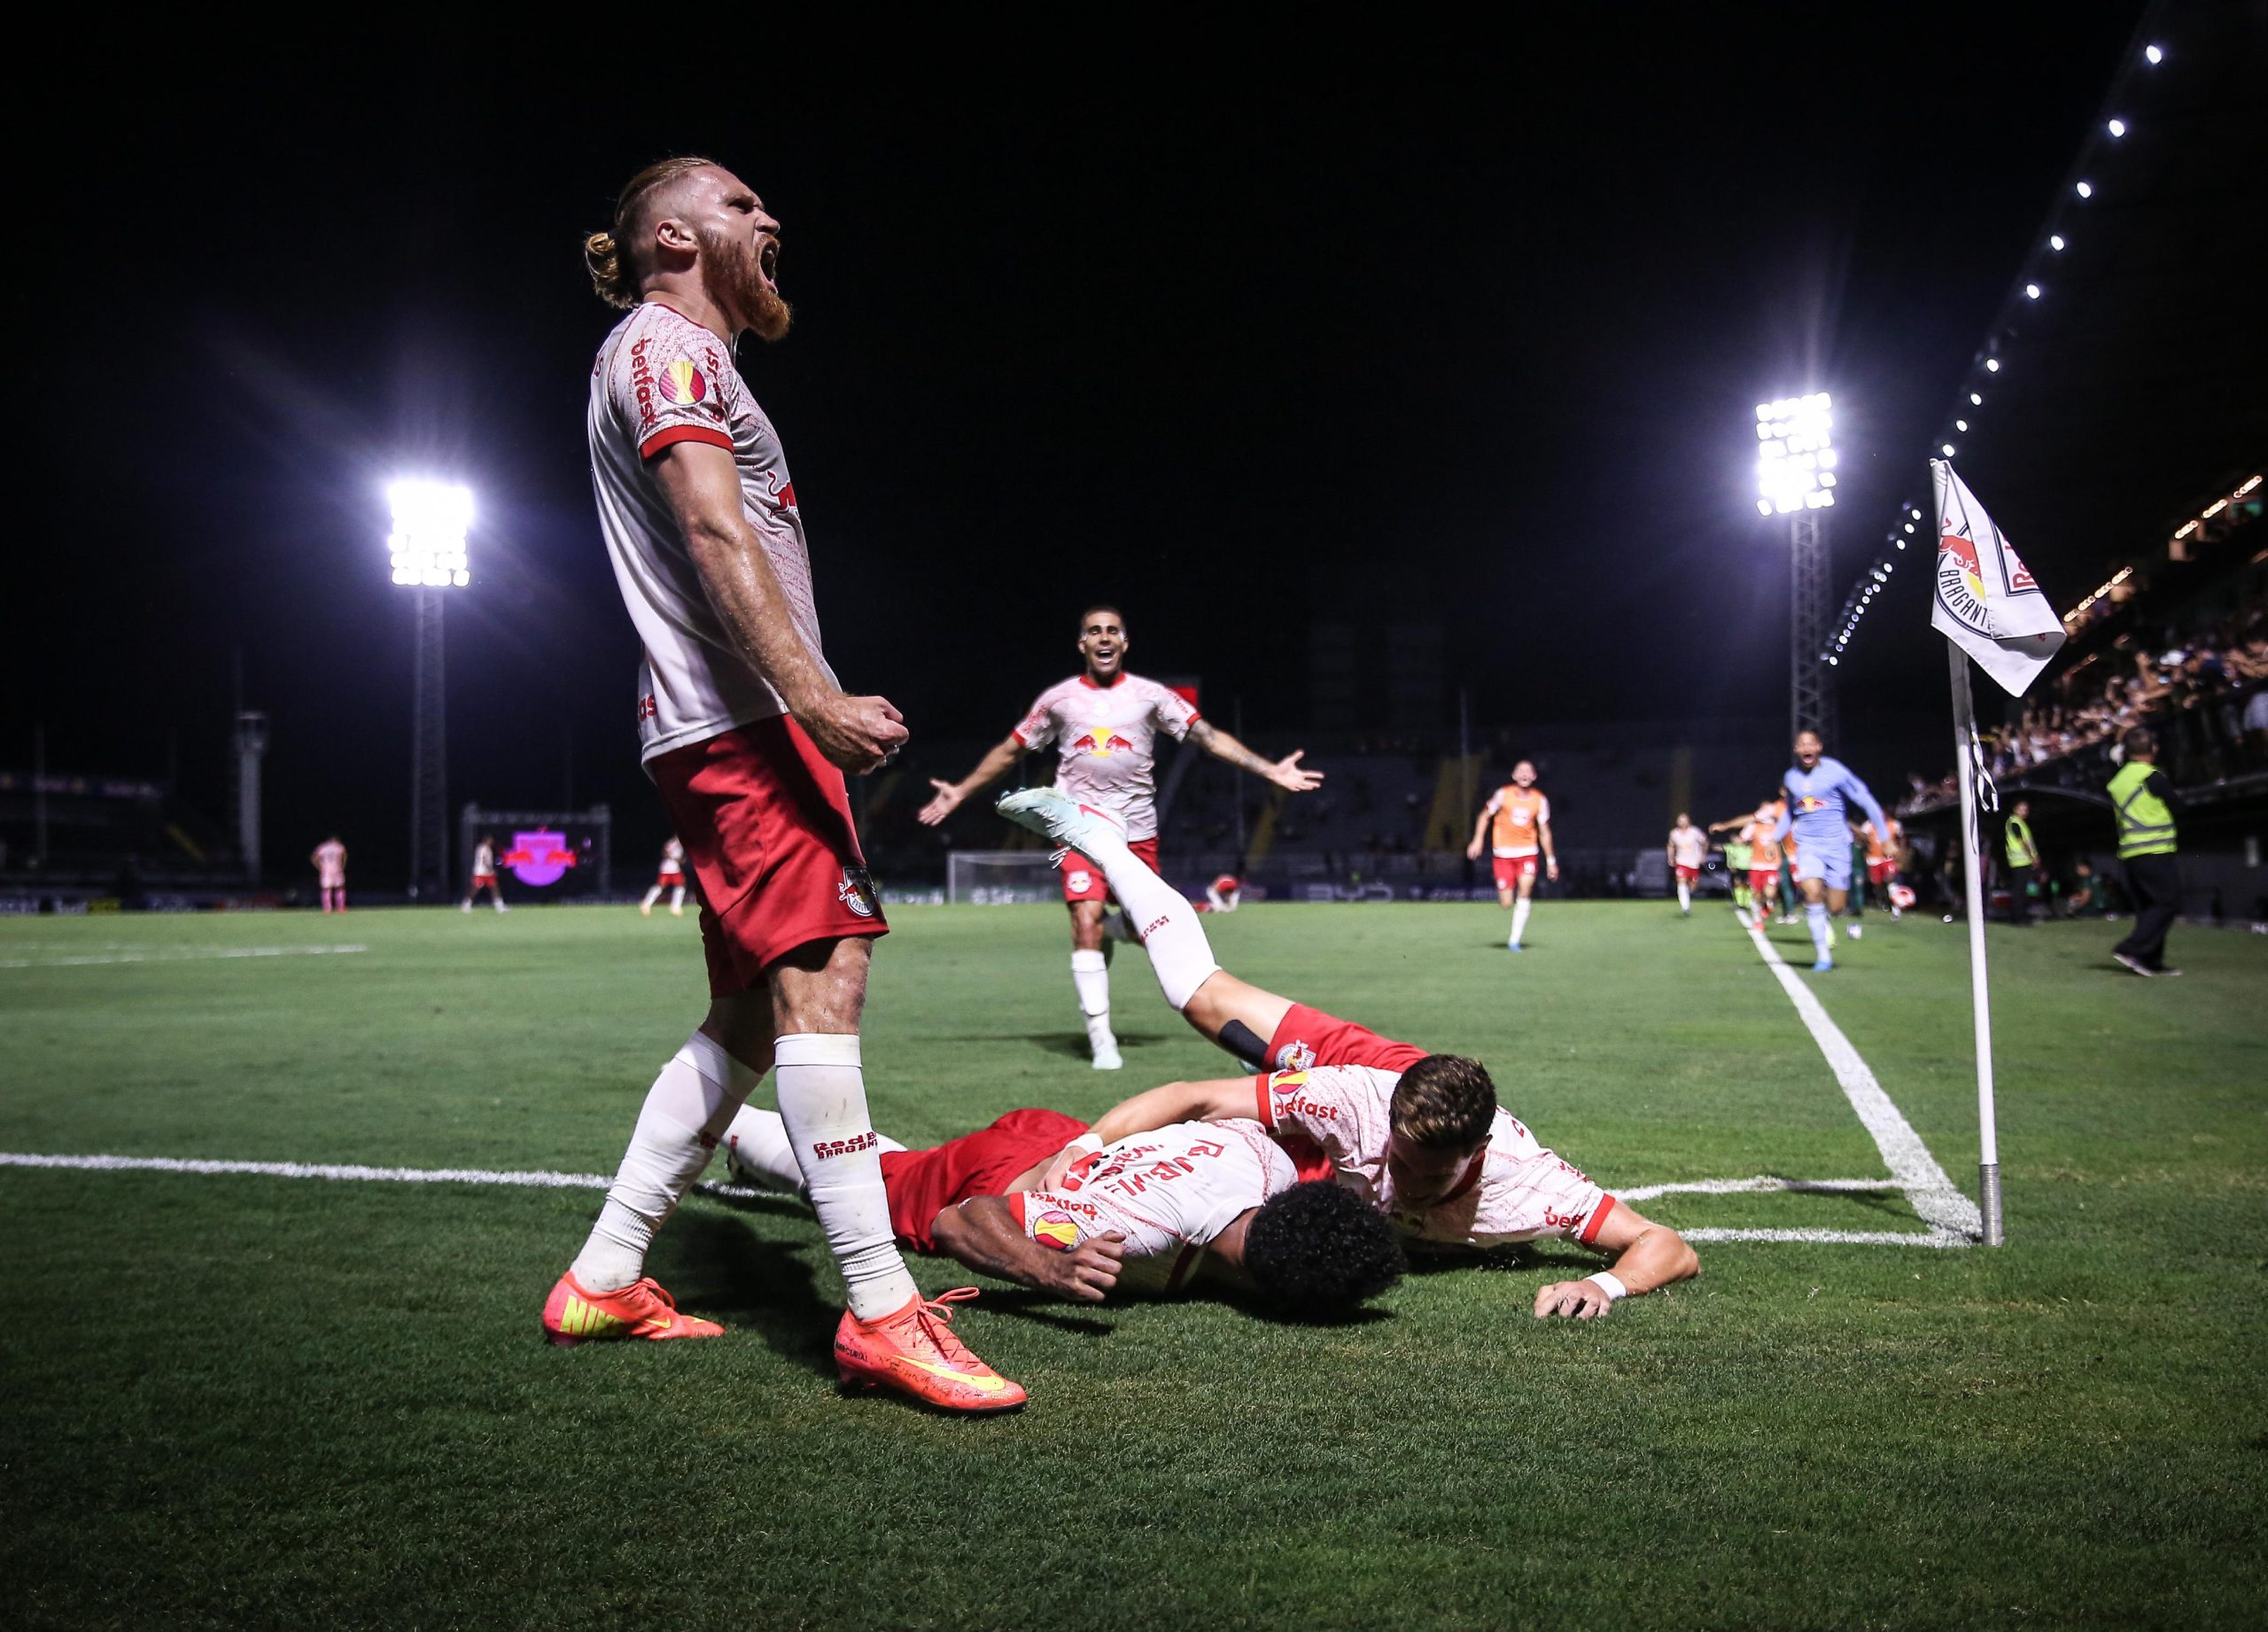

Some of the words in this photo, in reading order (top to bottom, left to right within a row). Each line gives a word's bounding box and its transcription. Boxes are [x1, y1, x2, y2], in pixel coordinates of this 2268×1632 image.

[631, 338, 657, 426] betfast
[1939, 570, 1992, 626] BRAGANT
[1275, 1096, 1339, 1121] befast
[813, 1135, 864, 1154] Red
